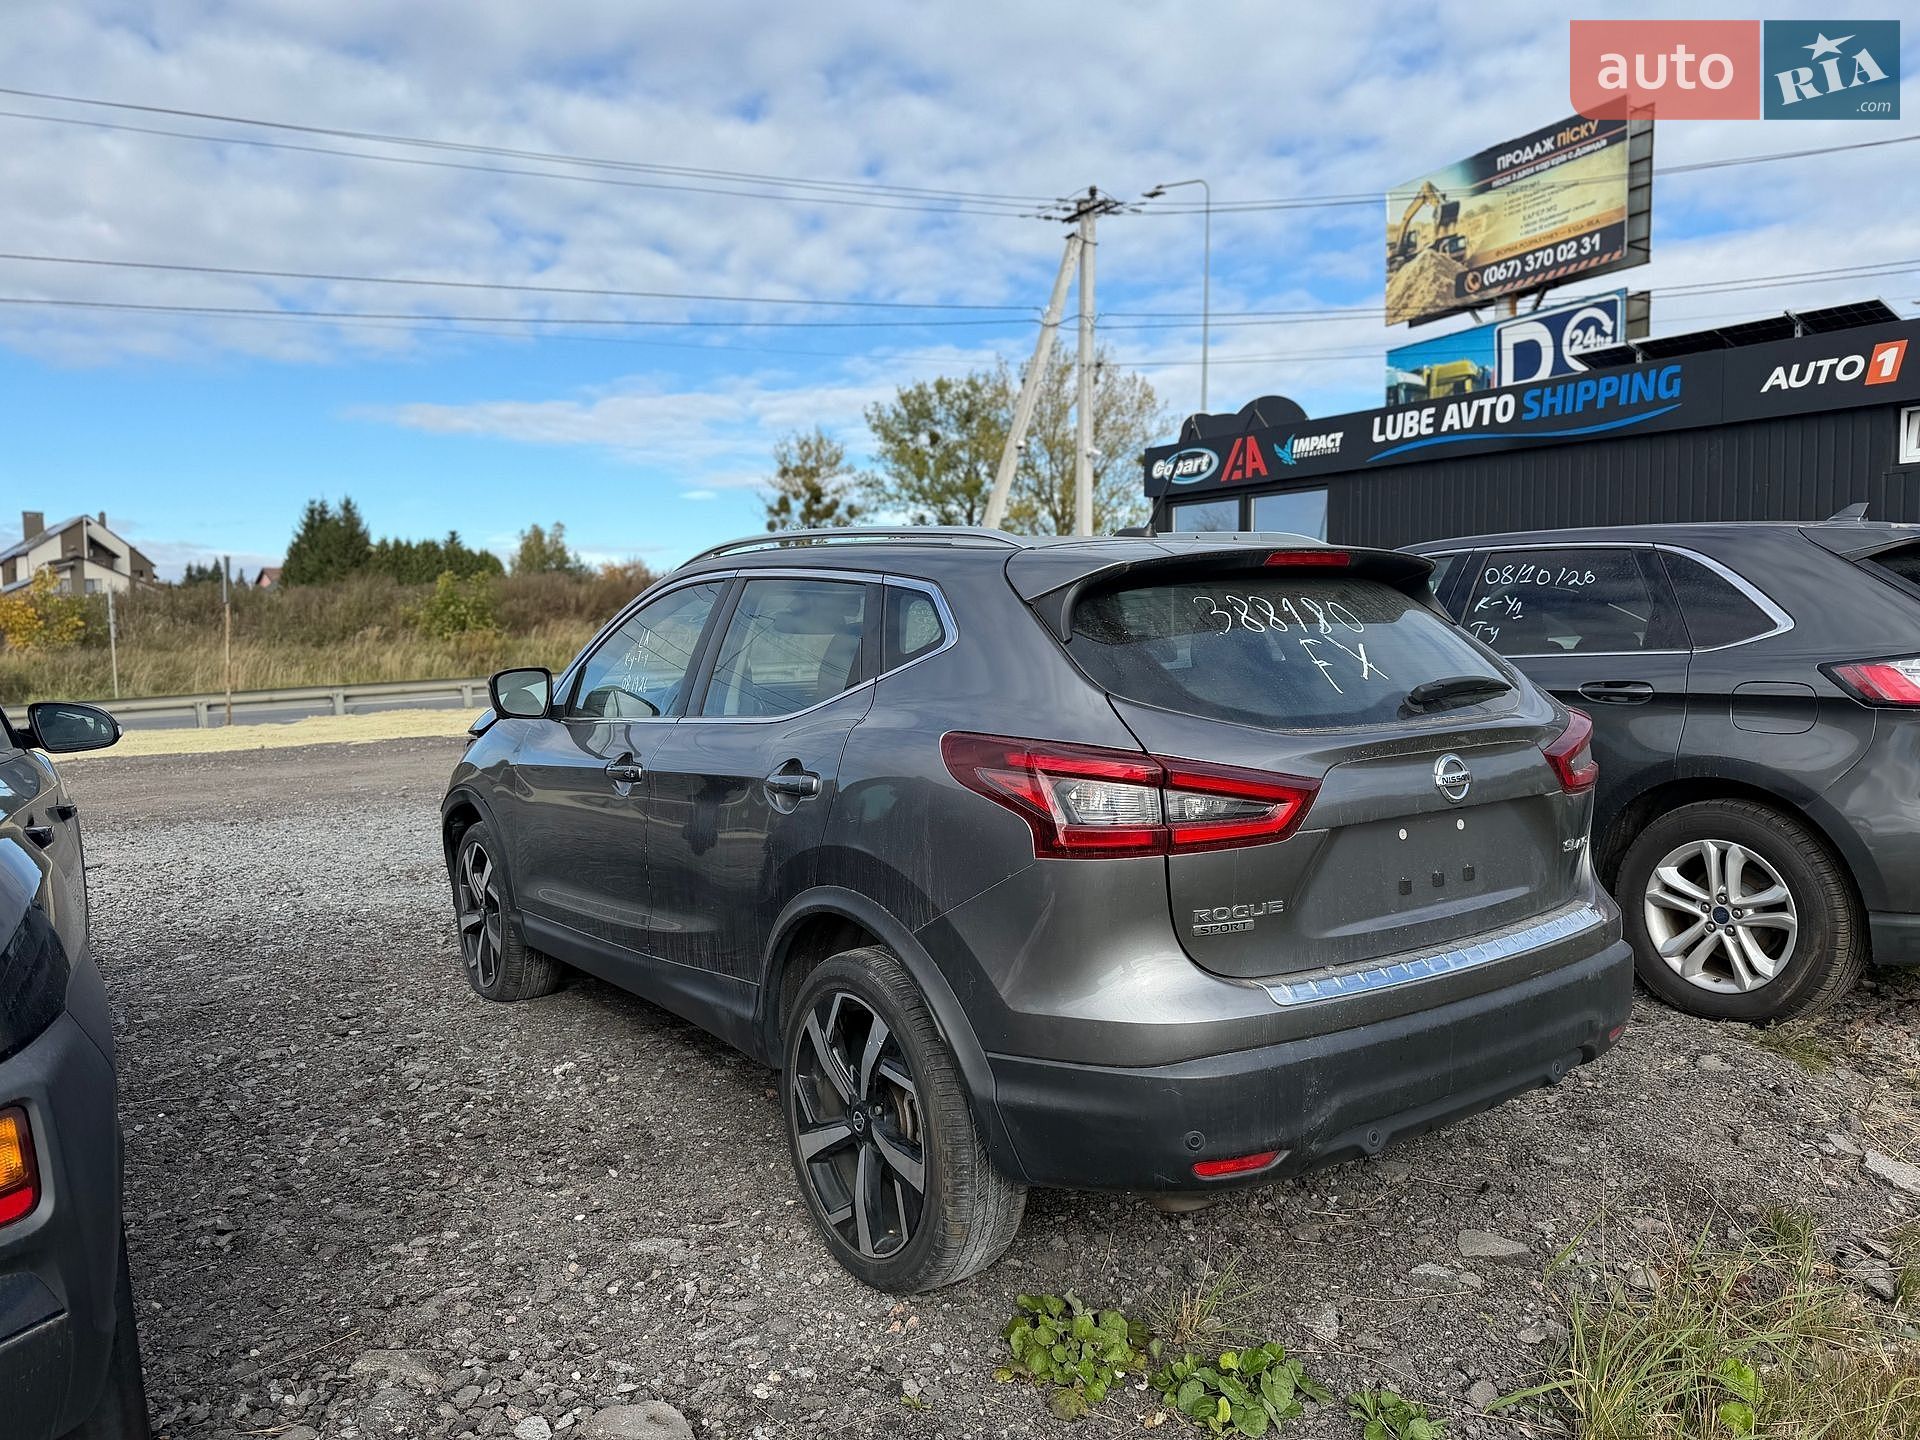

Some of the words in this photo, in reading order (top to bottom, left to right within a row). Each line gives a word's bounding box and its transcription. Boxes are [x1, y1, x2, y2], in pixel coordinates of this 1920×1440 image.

[1496, 136, 1555, 171] ПРОДАЖ
[1483, 259, 1521, 286] (067)
[1524, 247, 1554, 272] 370
[1556, 240, 1577, 262] 02
[1580, 233, 1600, 255] 31
[1760, 353, 1865, 393] AUTO
[1372, 406, 1436, 443] LUBE
[1441, 393, 1515, 432] AVTO
[1522, 365, 1682, 421] SHIPPING
[1292, 431, 1344, 453] IMPACT
[1152, 453, 1210, 479] Copart
[1193, 595, 1365, 636] 388180
[1441, 772, 1470, 785] NISSAN
[1192, 900, 1284, 923] ROGUE
[1200, 921, 1249, 935] SPORT
